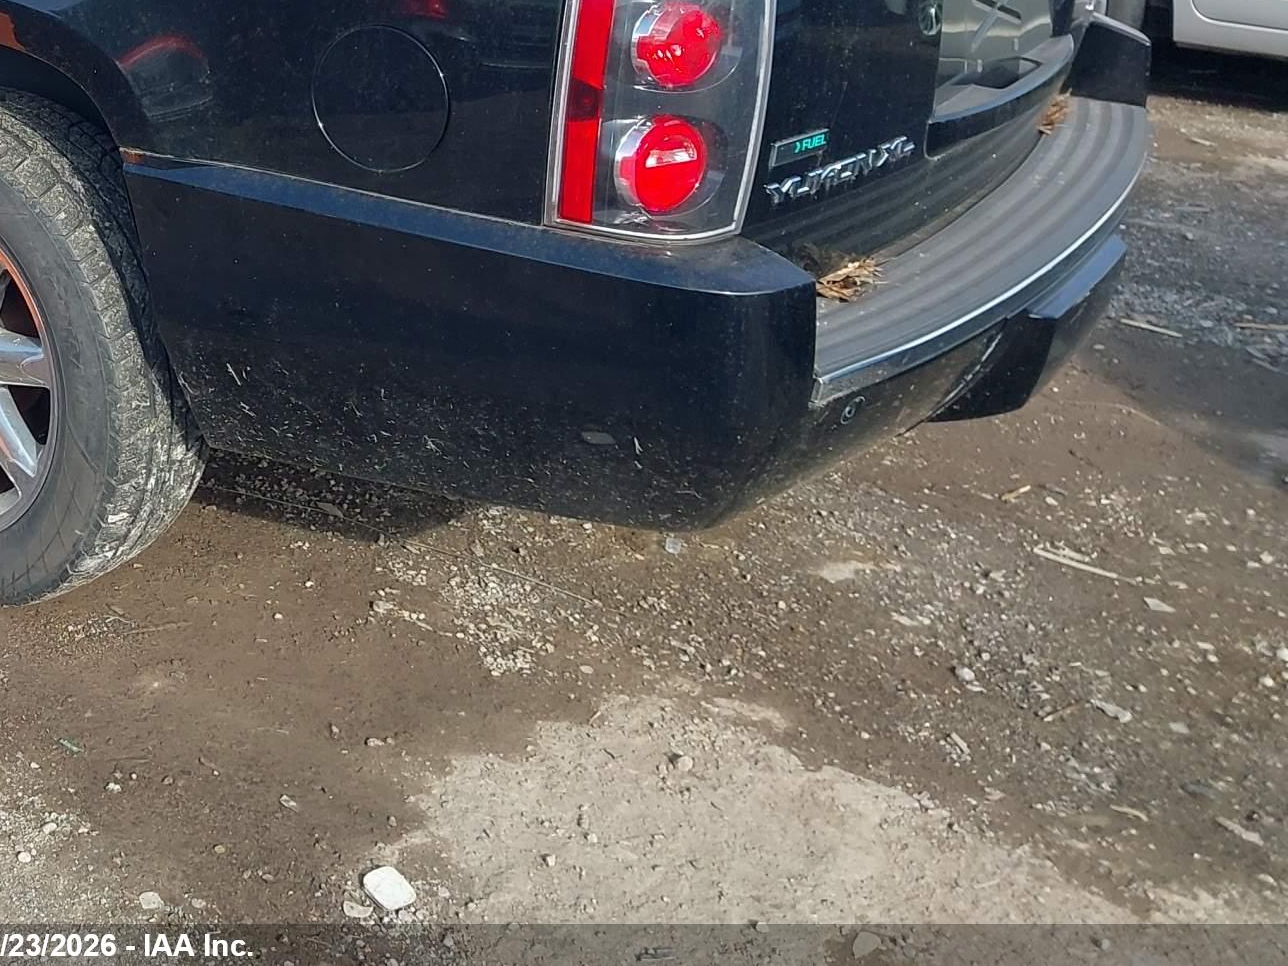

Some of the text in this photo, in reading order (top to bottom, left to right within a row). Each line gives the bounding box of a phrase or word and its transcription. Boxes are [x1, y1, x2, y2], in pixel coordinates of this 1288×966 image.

[801, 134, 827, 152] FUEL
[763, 136, 915, 205] YUKON XL
